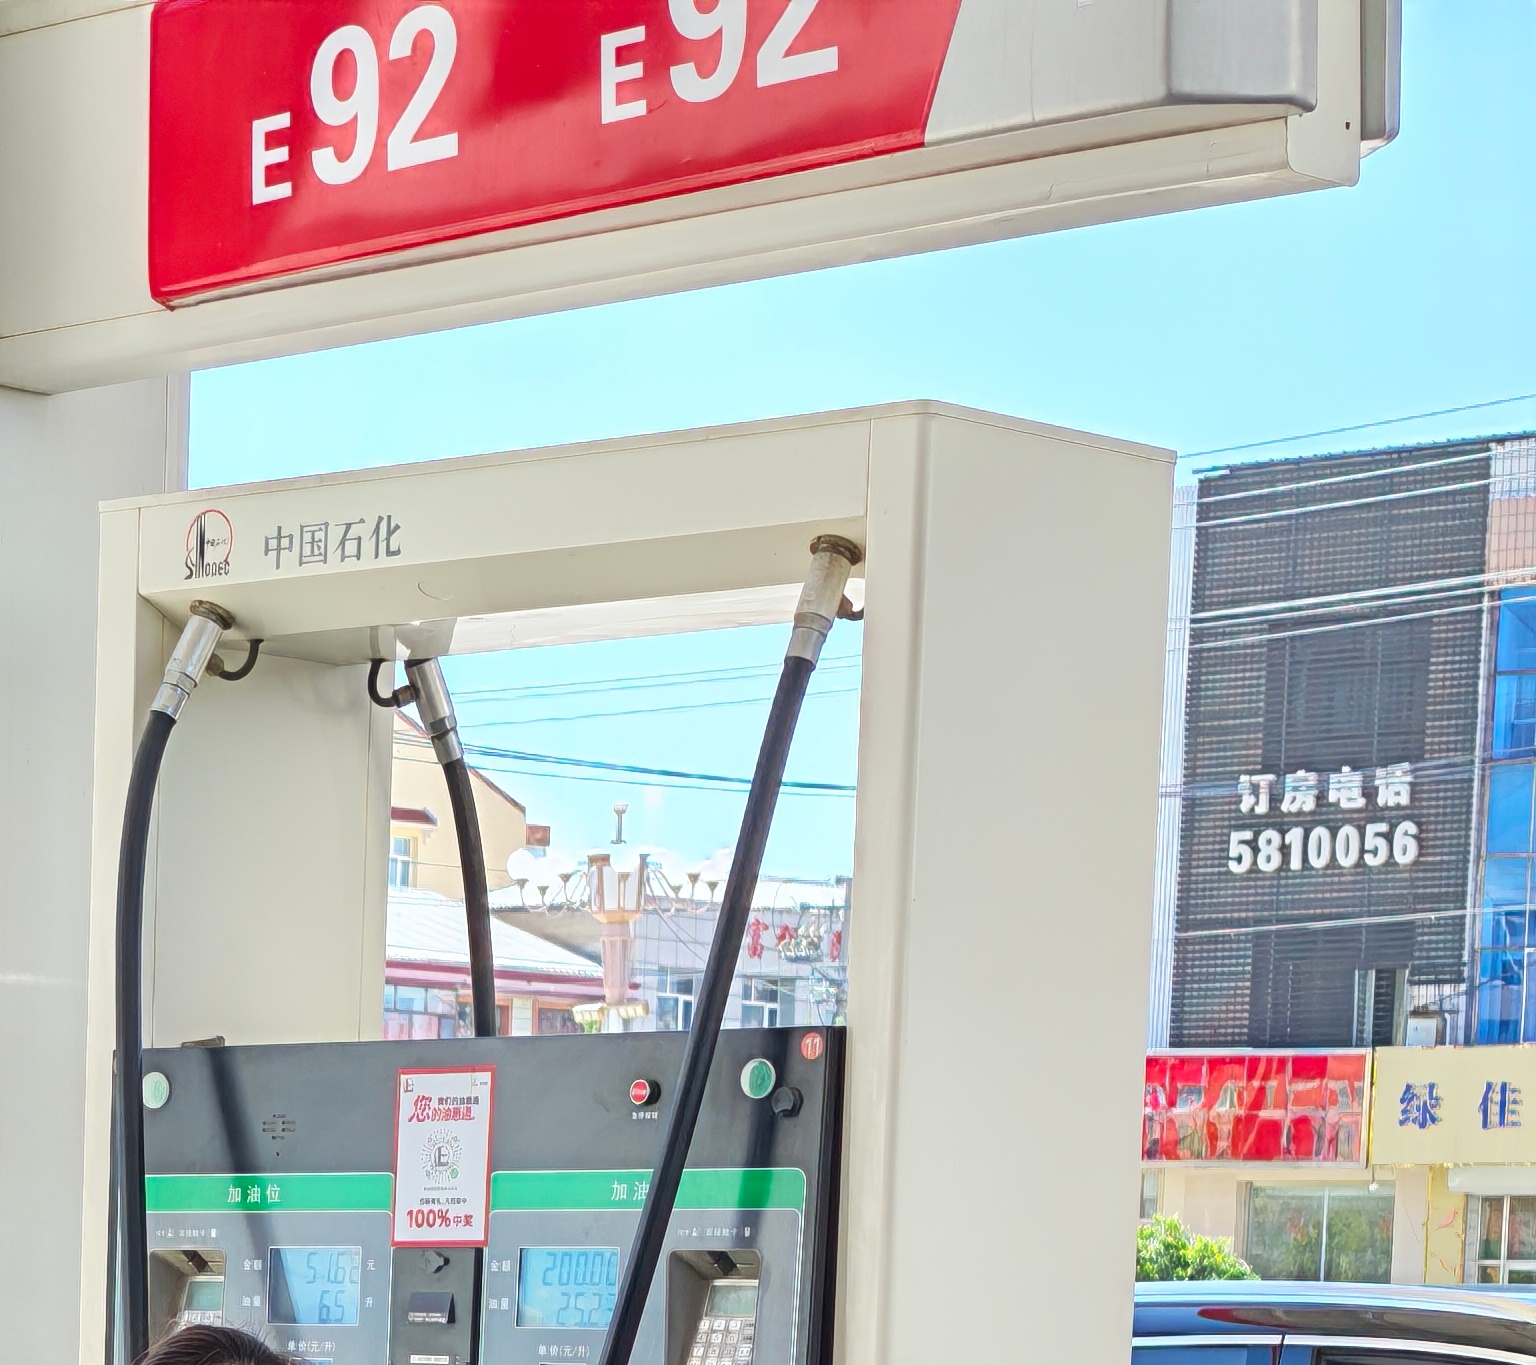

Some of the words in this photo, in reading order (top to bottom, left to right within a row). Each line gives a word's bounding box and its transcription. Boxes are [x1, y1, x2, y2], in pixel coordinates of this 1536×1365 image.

[263, 514, 402, 570] 中国石化
[1238, 762, 1414, 815] 订房电话
[1228, 820, 1419, 874] 5810056
[805, 1036, 821, 1058] 11
[227, 1184, 282, 1204] 加油位
[366, 1259, 376, 1271] 元
